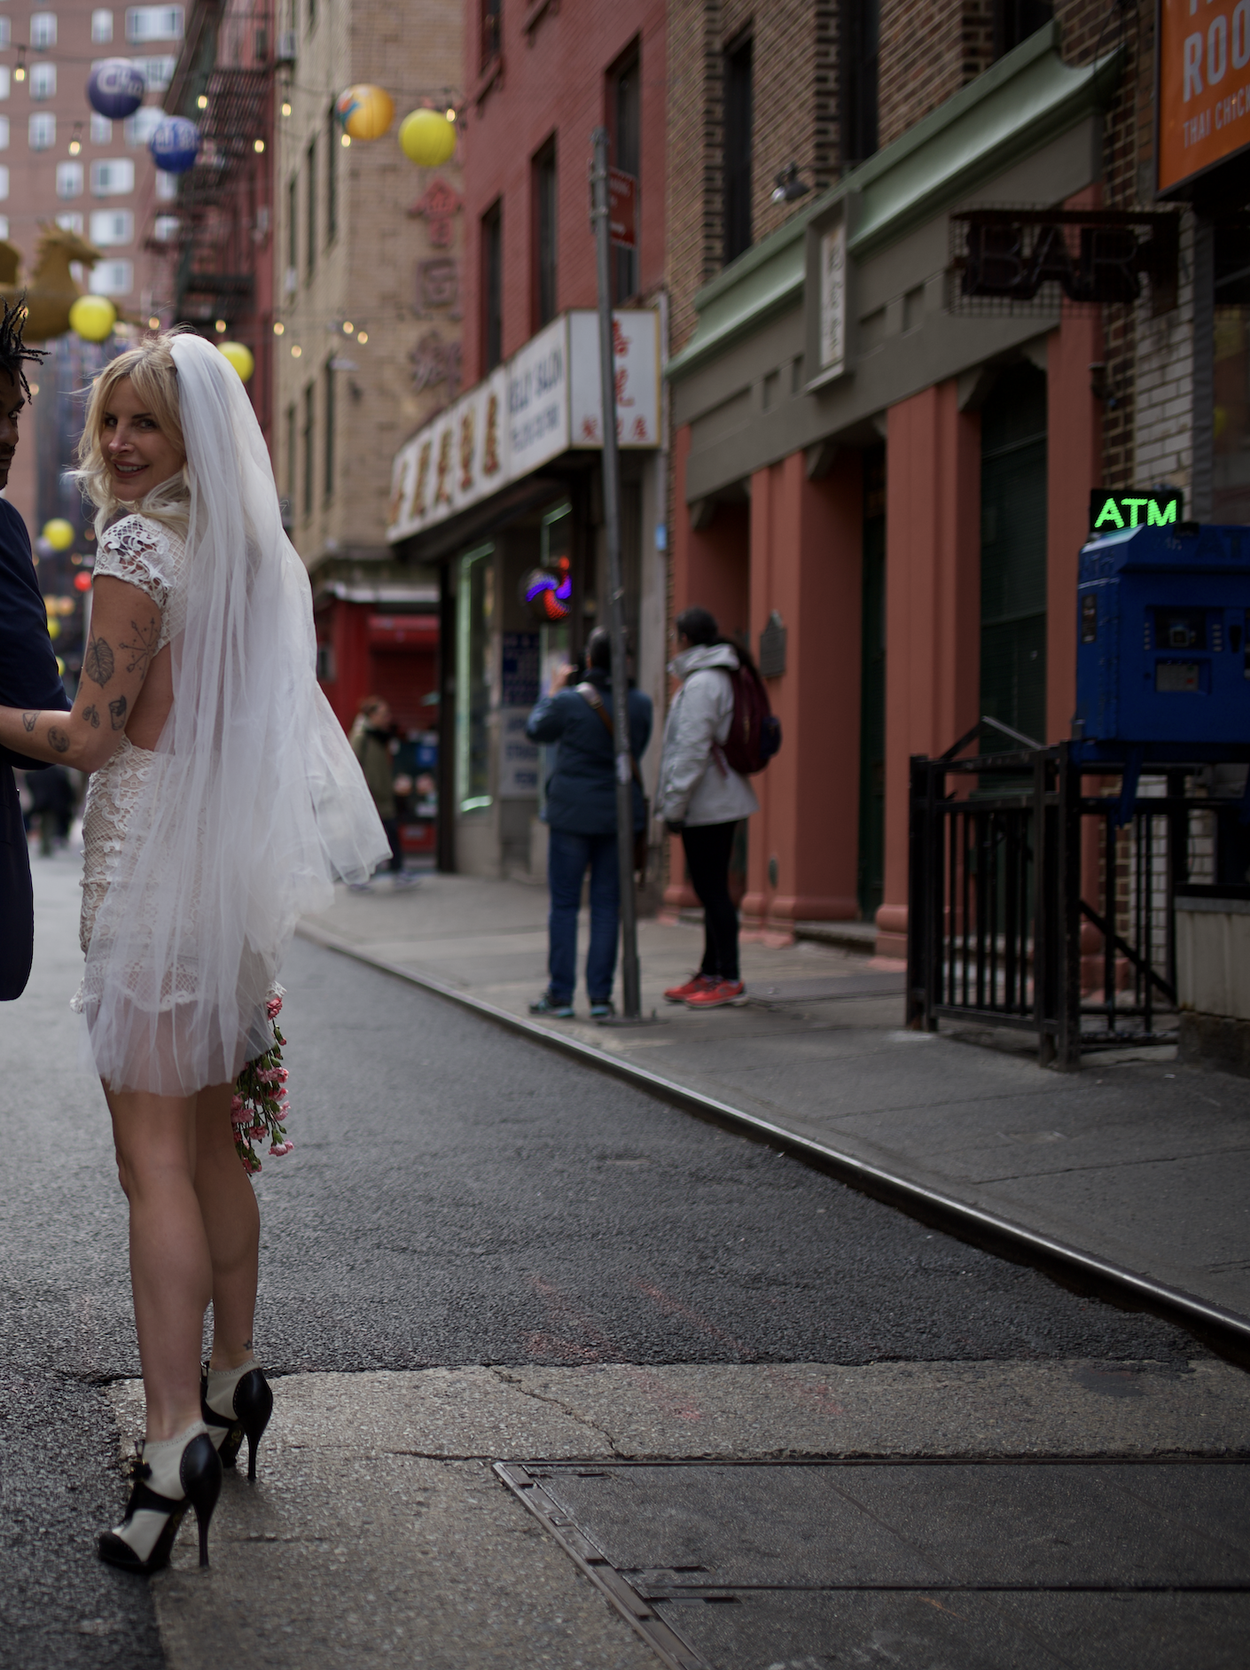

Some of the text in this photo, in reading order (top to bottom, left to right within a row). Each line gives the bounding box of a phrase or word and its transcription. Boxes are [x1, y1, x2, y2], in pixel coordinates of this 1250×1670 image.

[1183, 108, 1212, 149] THAI
[966, 224, 1140, 299] BAR
[1094, 497, 1177, 528] ATM
